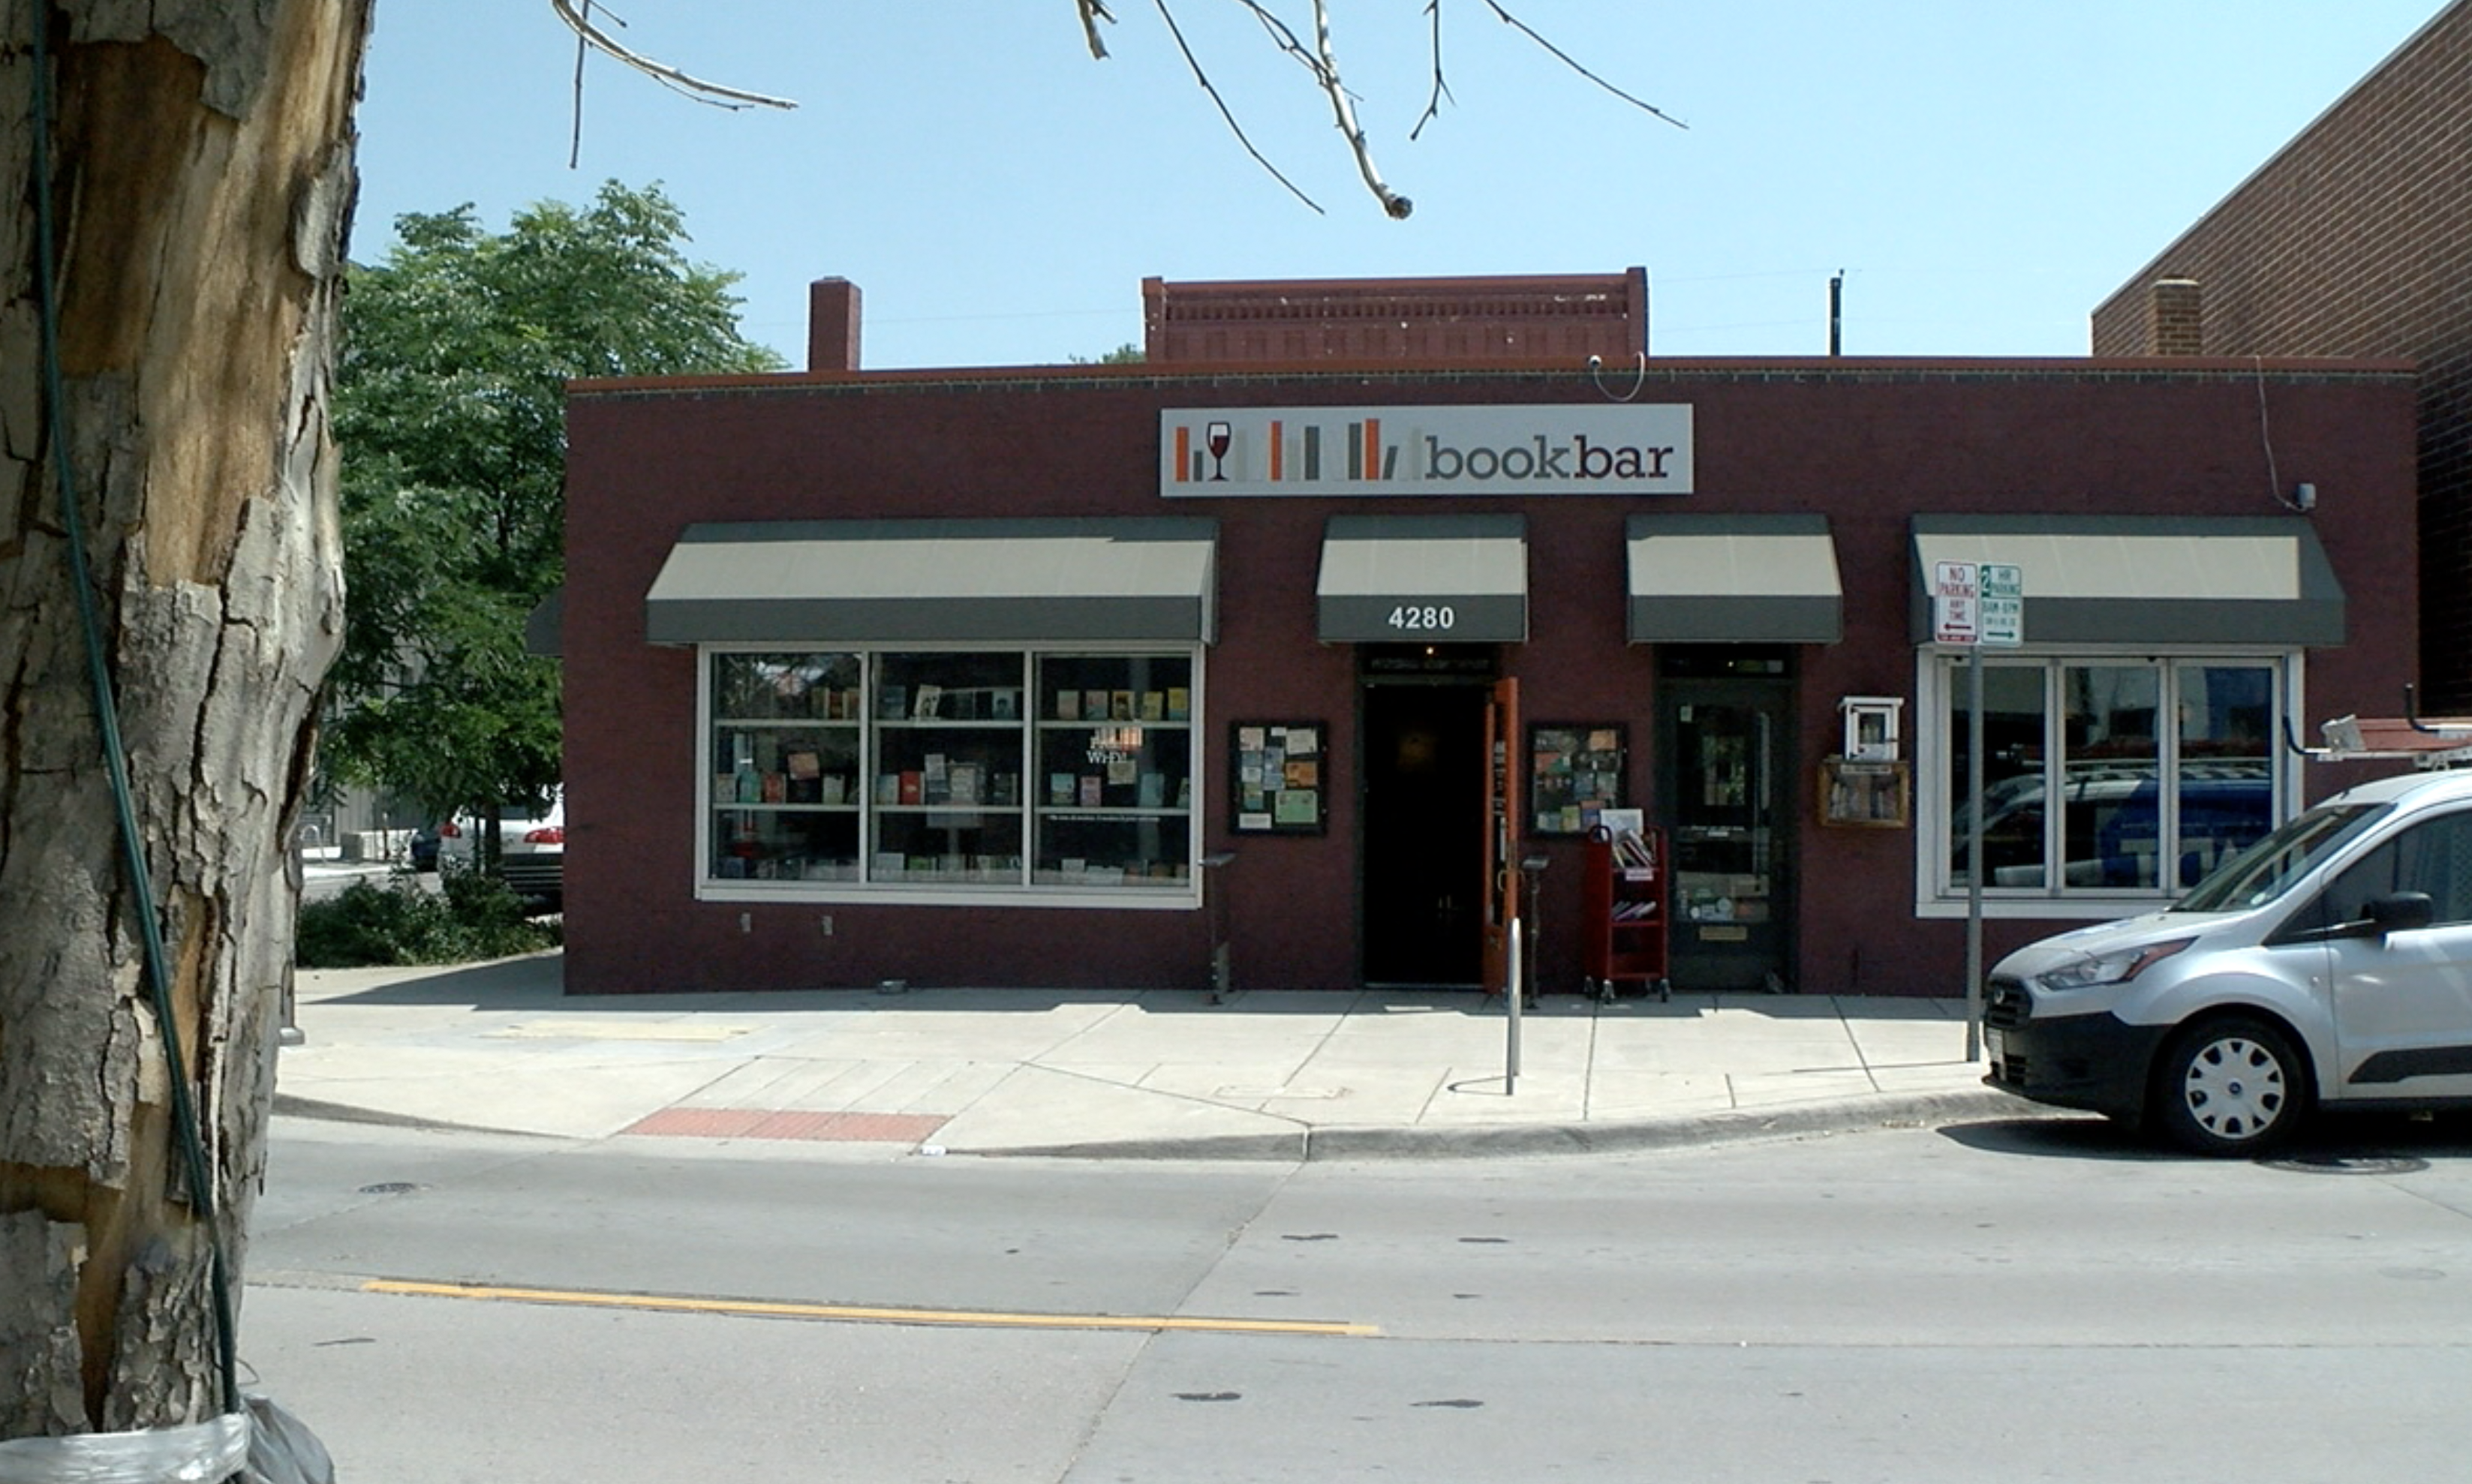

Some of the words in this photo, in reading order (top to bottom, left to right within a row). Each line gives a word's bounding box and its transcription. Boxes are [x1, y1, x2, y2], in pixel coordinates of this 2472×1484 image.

[1426, 435, 1674, 480] bookbar
[1949, 567, 1965, 582] NO
[1941, 583, 1974, 598] PARKING
[1388, 607, 1454, 629] 4280
